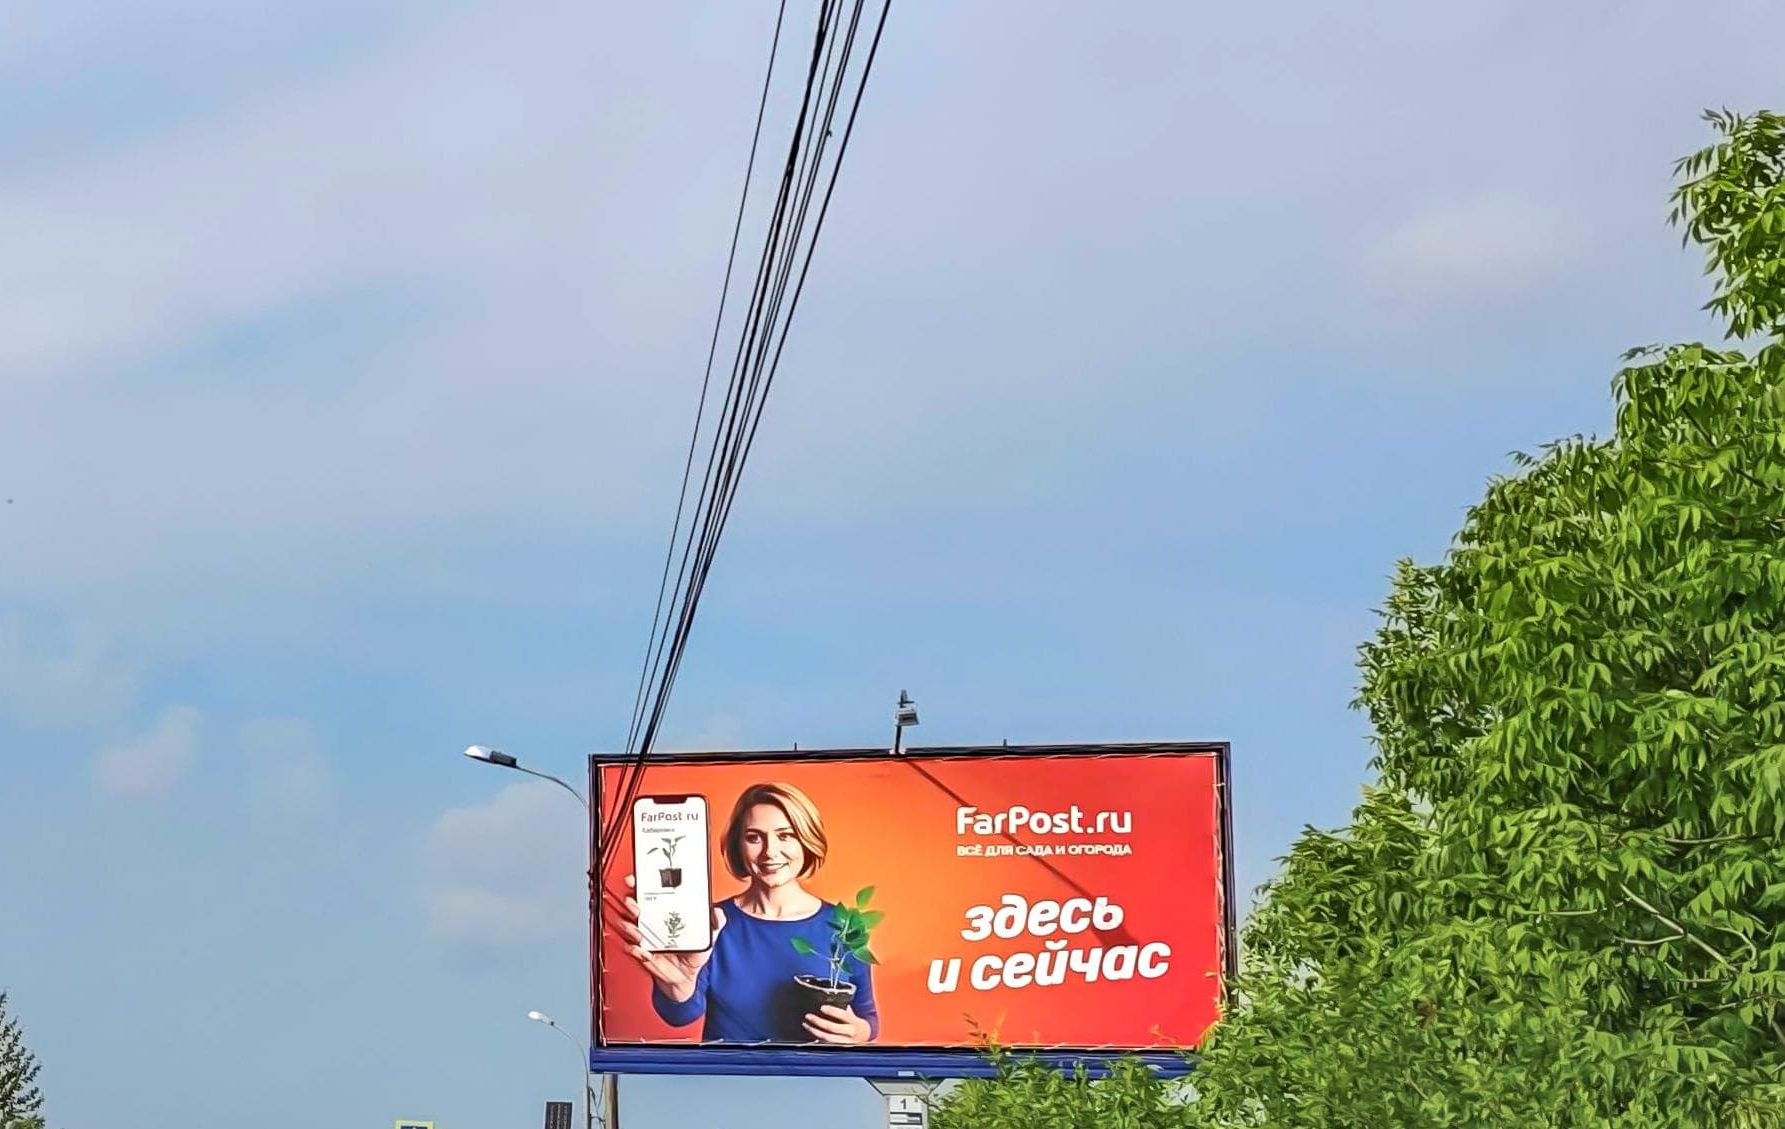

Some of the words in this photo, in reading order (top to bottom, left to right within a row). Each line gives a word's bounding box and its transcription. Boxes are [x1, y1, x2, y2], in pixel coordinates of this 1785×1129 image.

[956, 804, 1132, 835] FarPost.ru
[957, 844, 983, 857] ВСЁ
[985, 845, 1013, 857] ДЛЯ
[1015, 844, 1053, 856] САДА
[1055, 845, 1066, 856] И
[1068, 844, 1132, 857] ОГОРОДА
[960, 893, 1125, 942] здесь
[927, 957, 962, 994] и
[970, 939, 1172, 991] сейчас
